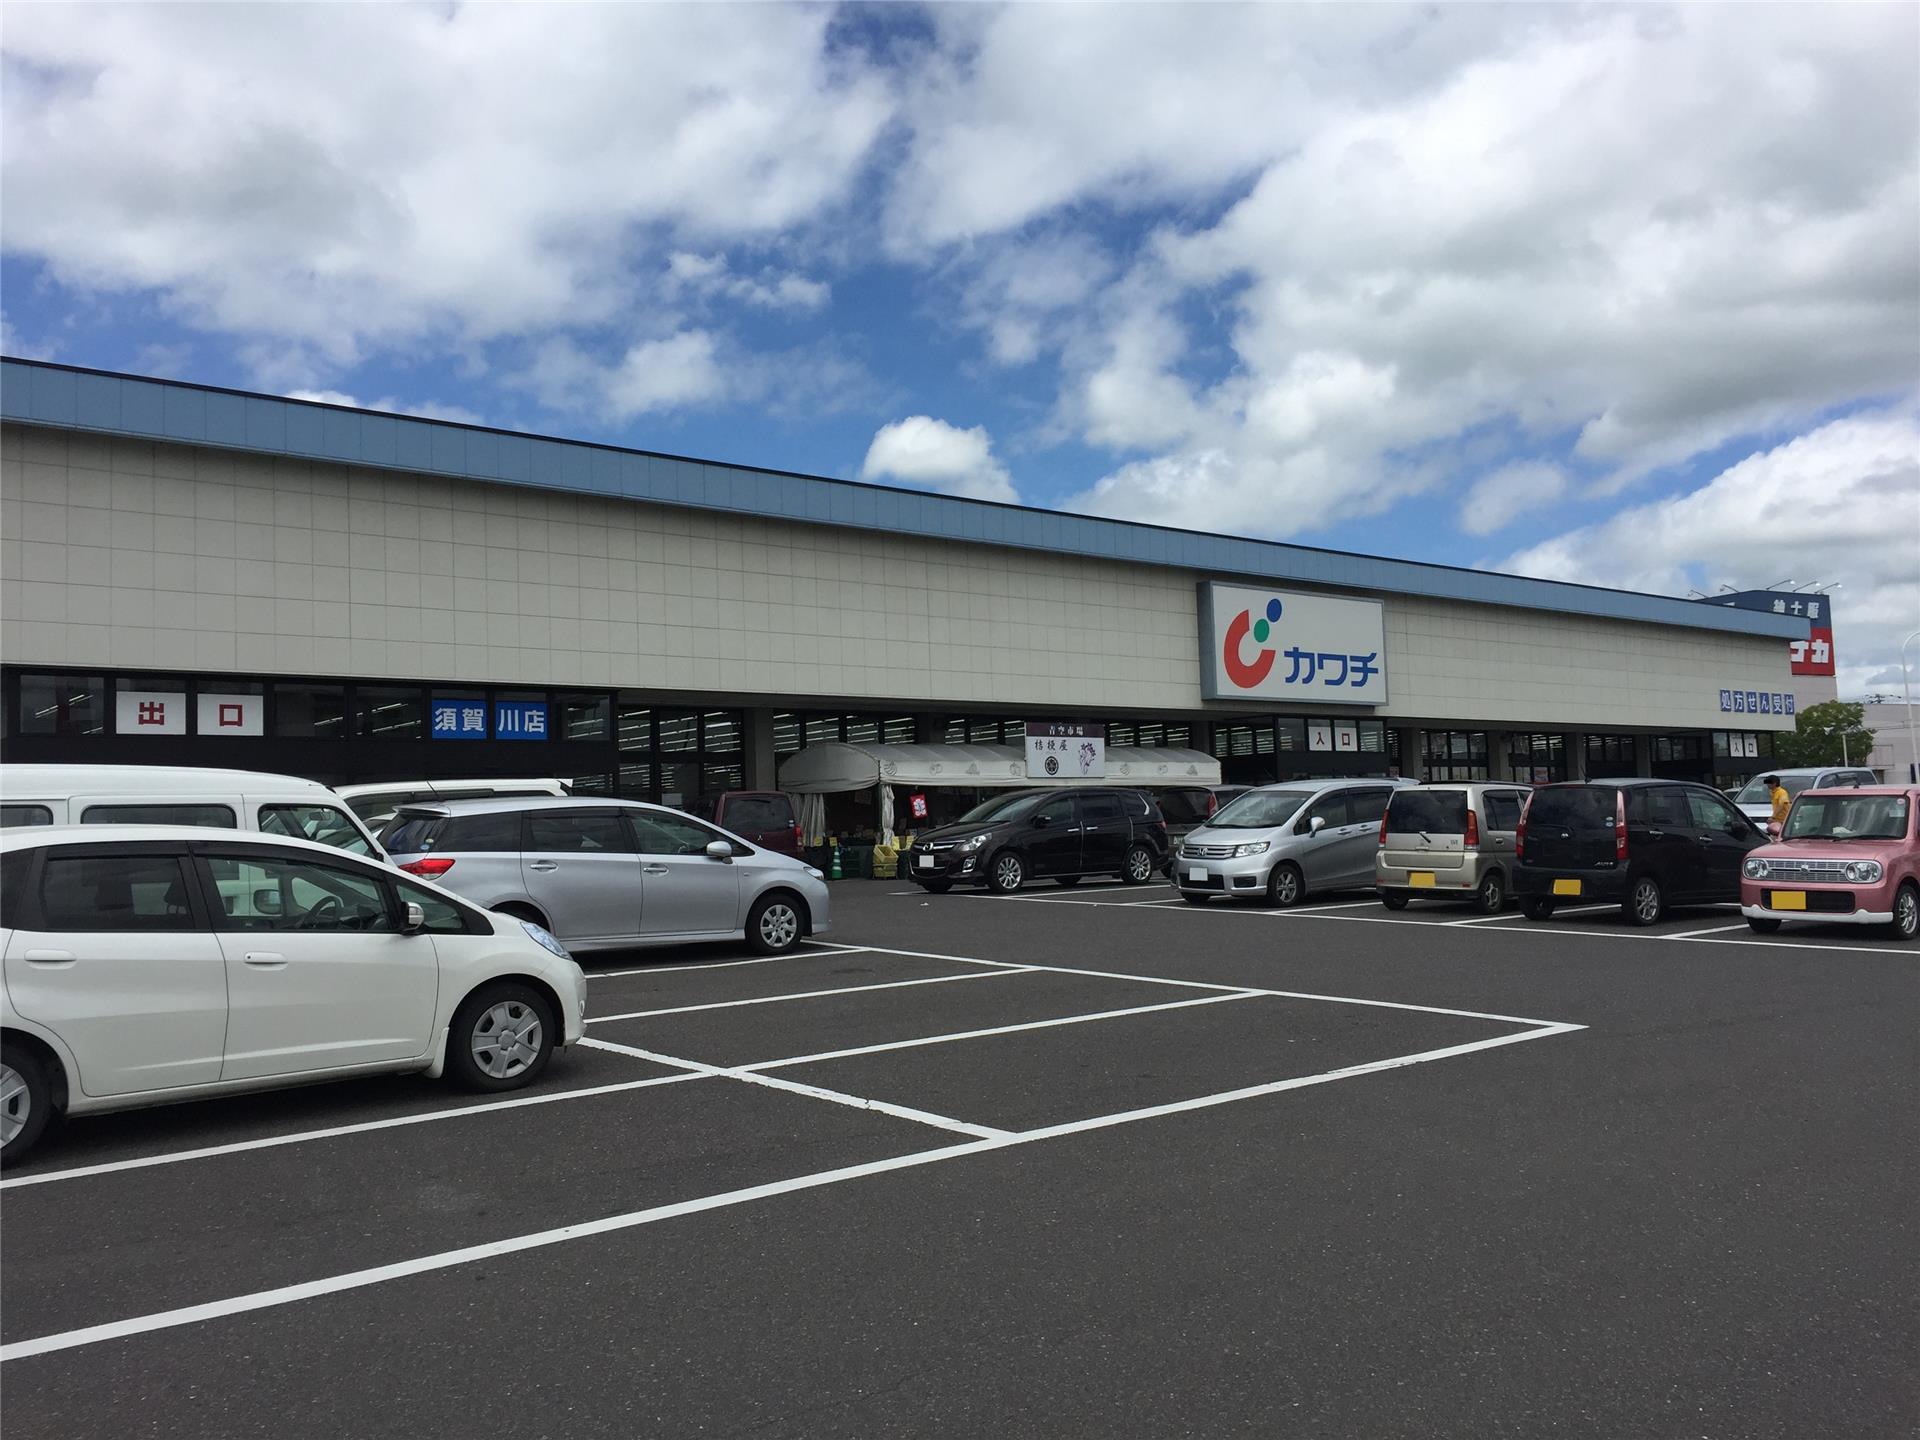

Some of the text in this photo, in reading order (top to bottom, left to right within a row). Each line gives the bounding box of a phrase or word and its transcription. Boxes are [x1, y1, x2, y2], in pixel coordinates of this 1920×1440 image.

[1284, 647, 1379, 687] カワチ
[138, 701, 243, 727] 出口
[1720, 690, 1794, 713] 処方せん受付
[434, 707, 545, 733] 須賀川店
[1316, 732, 1351, 746] 入口
